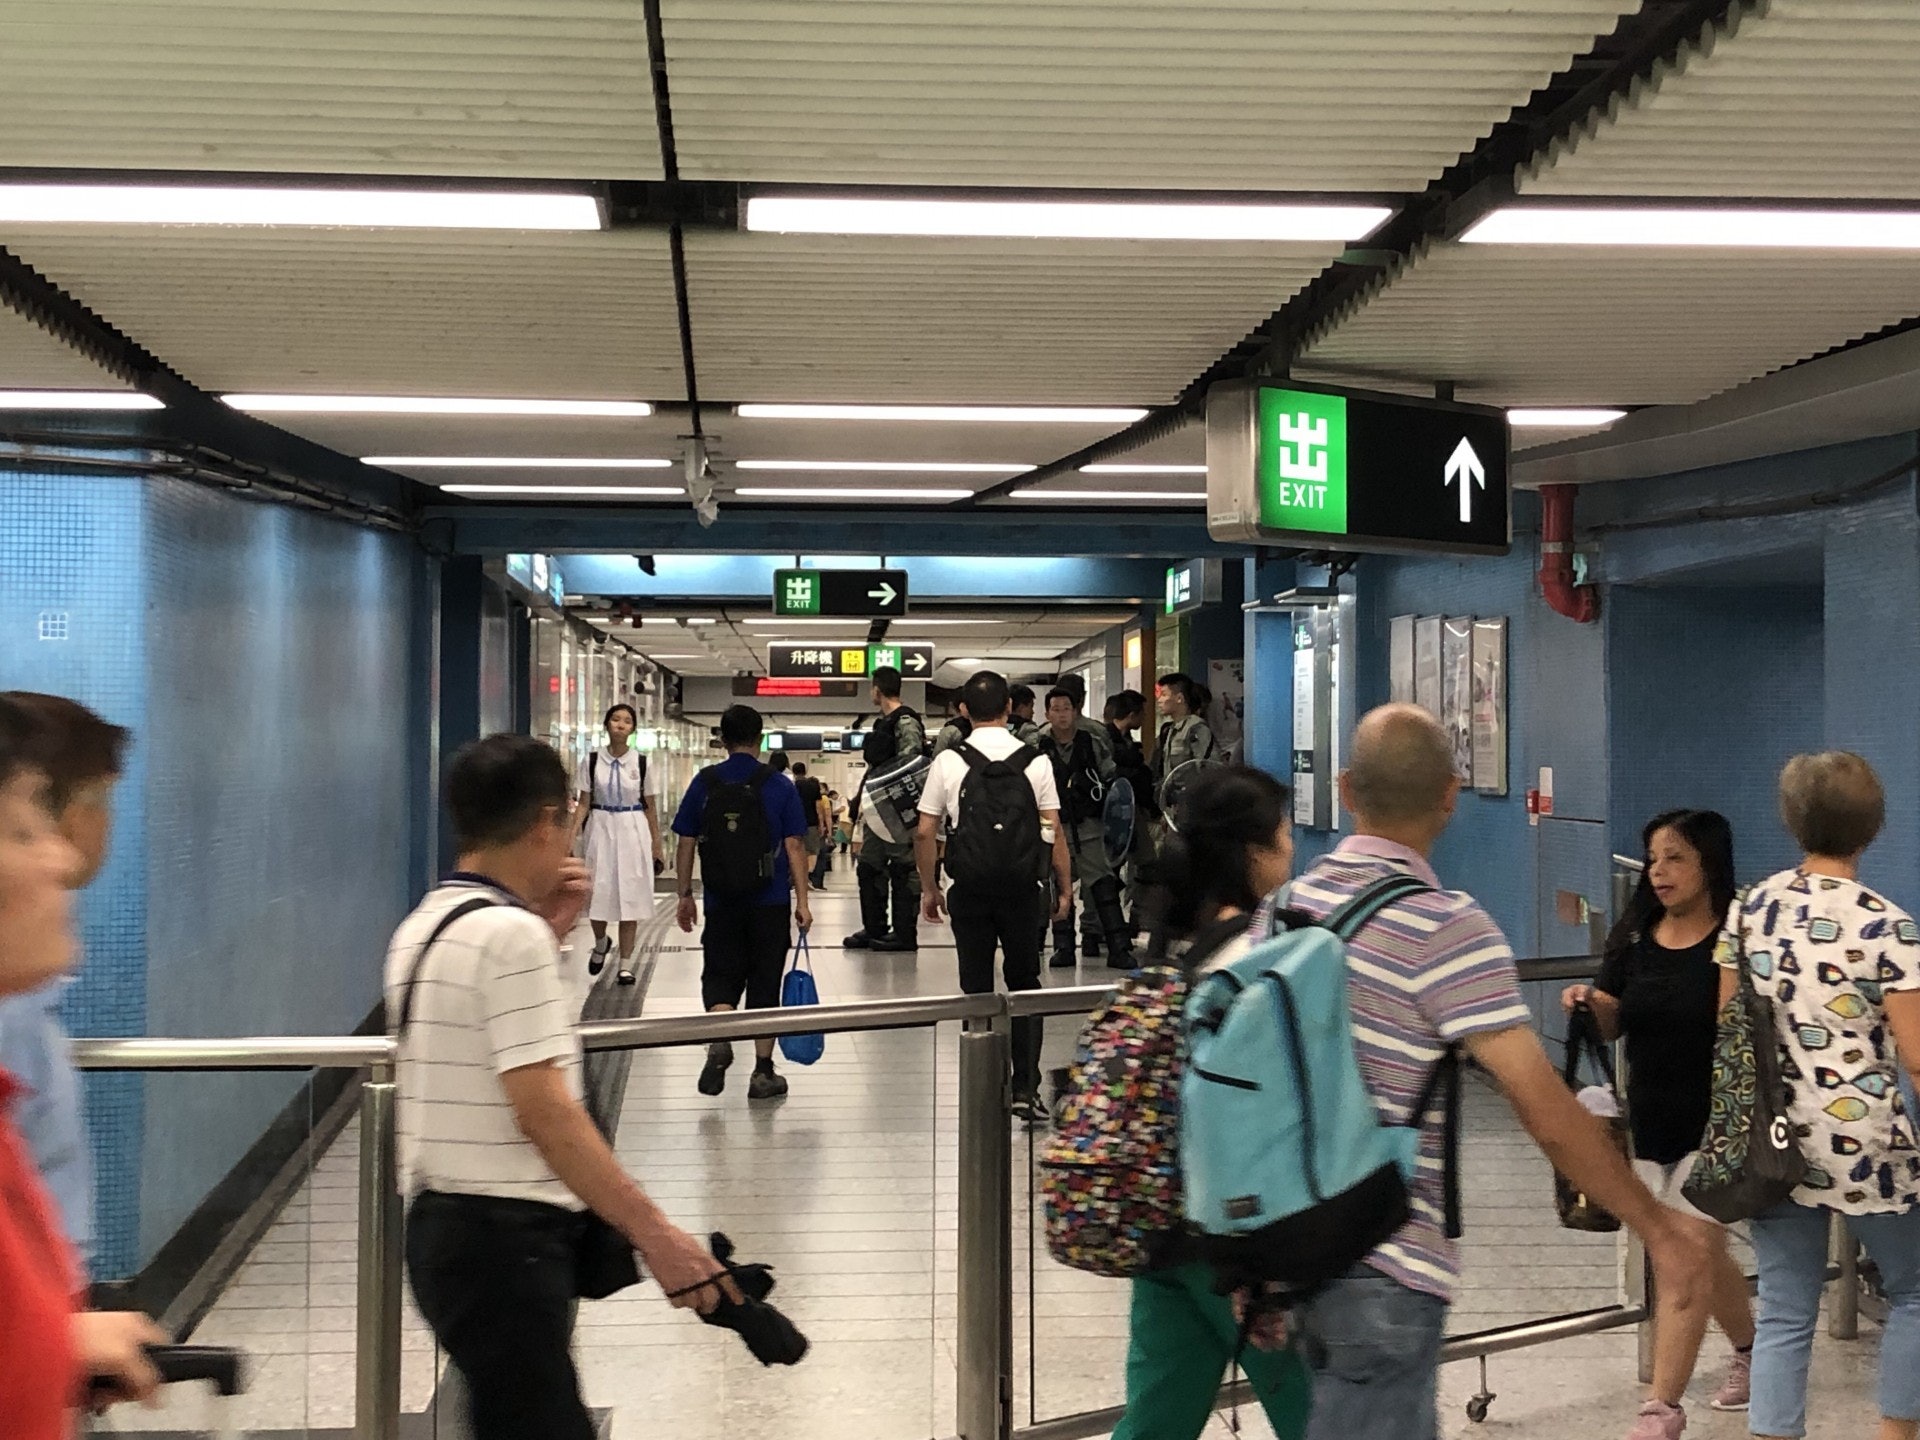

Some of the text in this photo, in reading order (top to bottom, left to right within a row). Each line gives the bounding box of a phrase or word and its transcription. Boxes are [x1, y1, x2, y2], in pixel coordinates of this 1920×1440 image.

[1279, 412, 1328, 482] 出
[1279, 482, 1328, 509] EXIT
[786, 577, 811, 600] 出
[786, 600, 811, 609] EXIT
[790, 650, 833, 665] 升降機
[820, 666, 833, 674] Lift
